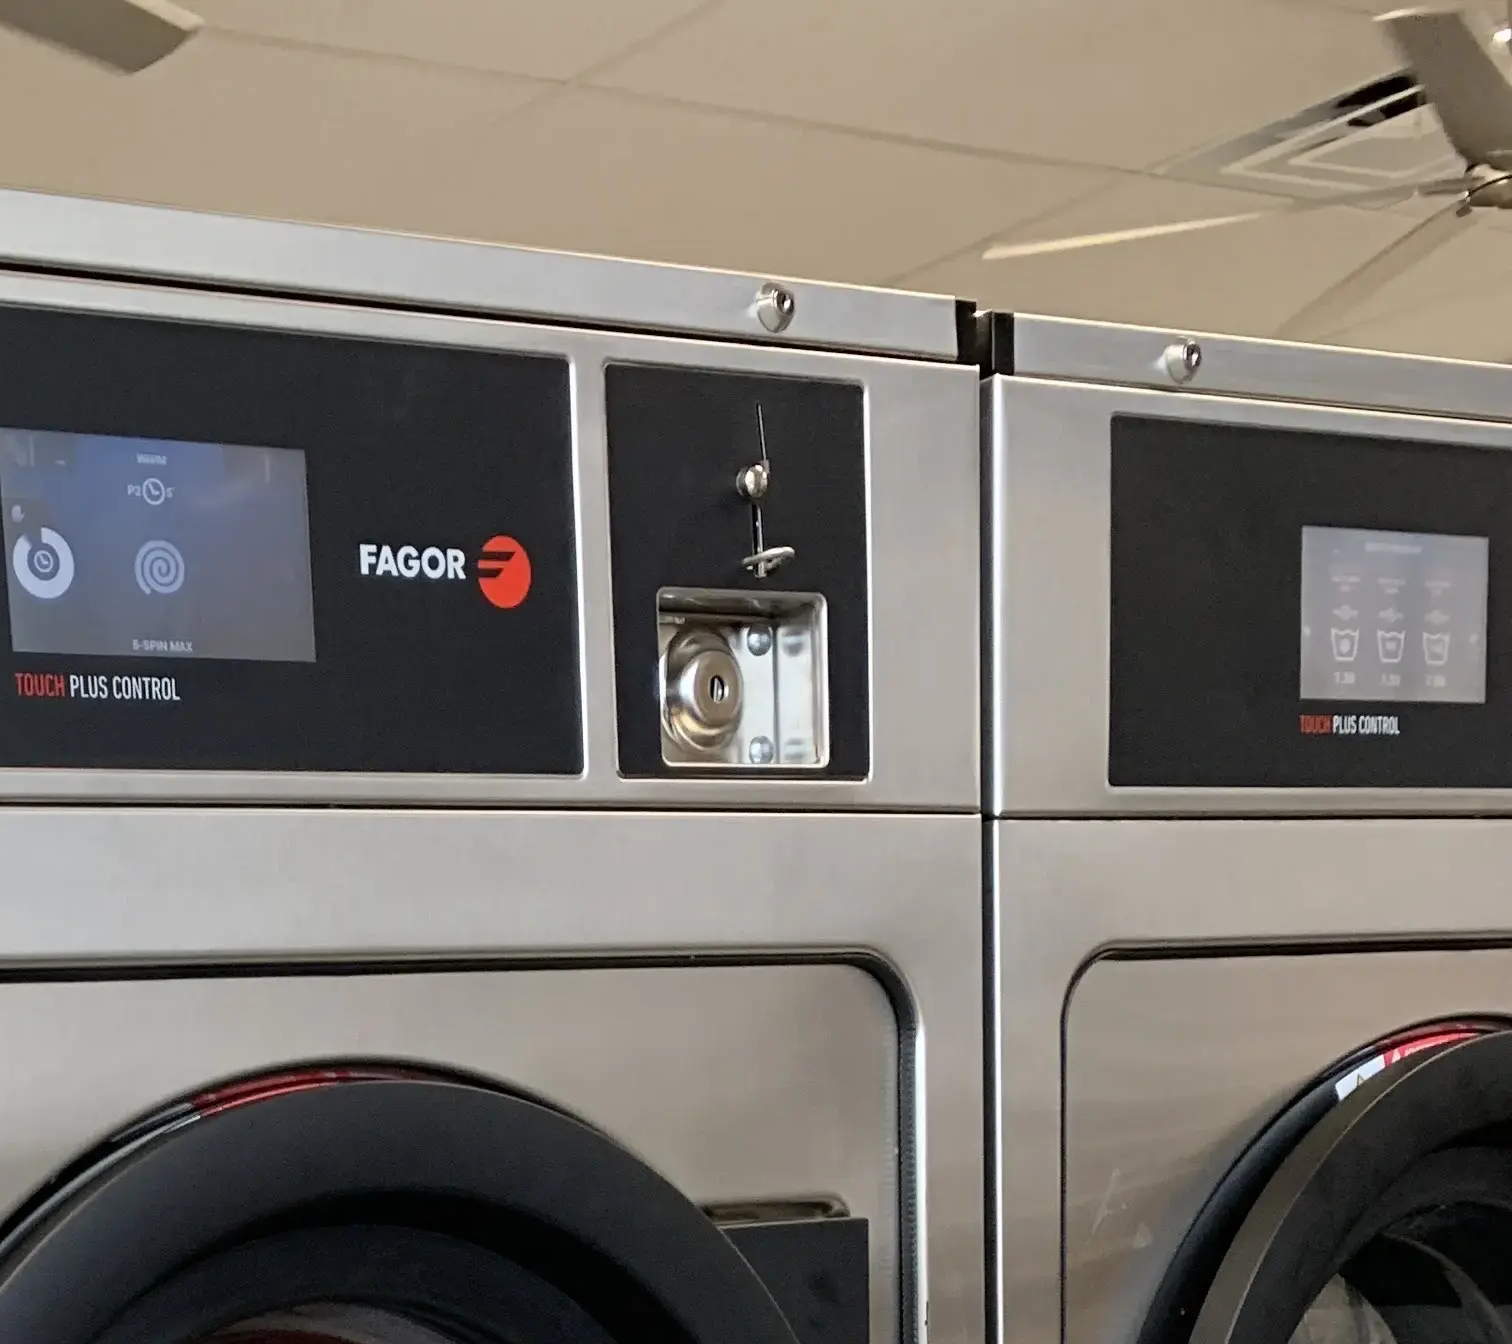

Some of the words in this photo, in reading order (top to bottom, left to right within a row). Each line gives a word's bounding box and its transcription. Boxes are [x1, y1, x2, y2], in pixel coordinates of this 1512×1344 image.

[358, 543, 467, 580] FAGOR
[14, 672, 65, 697] TOUCH
[69, 674, 109, 699] PLUS
[112, 675, 181, 701] CONTROL
[1332, 714, 1357, 735] PLUS
[1358, 715, 1401, 736] CONTROL
